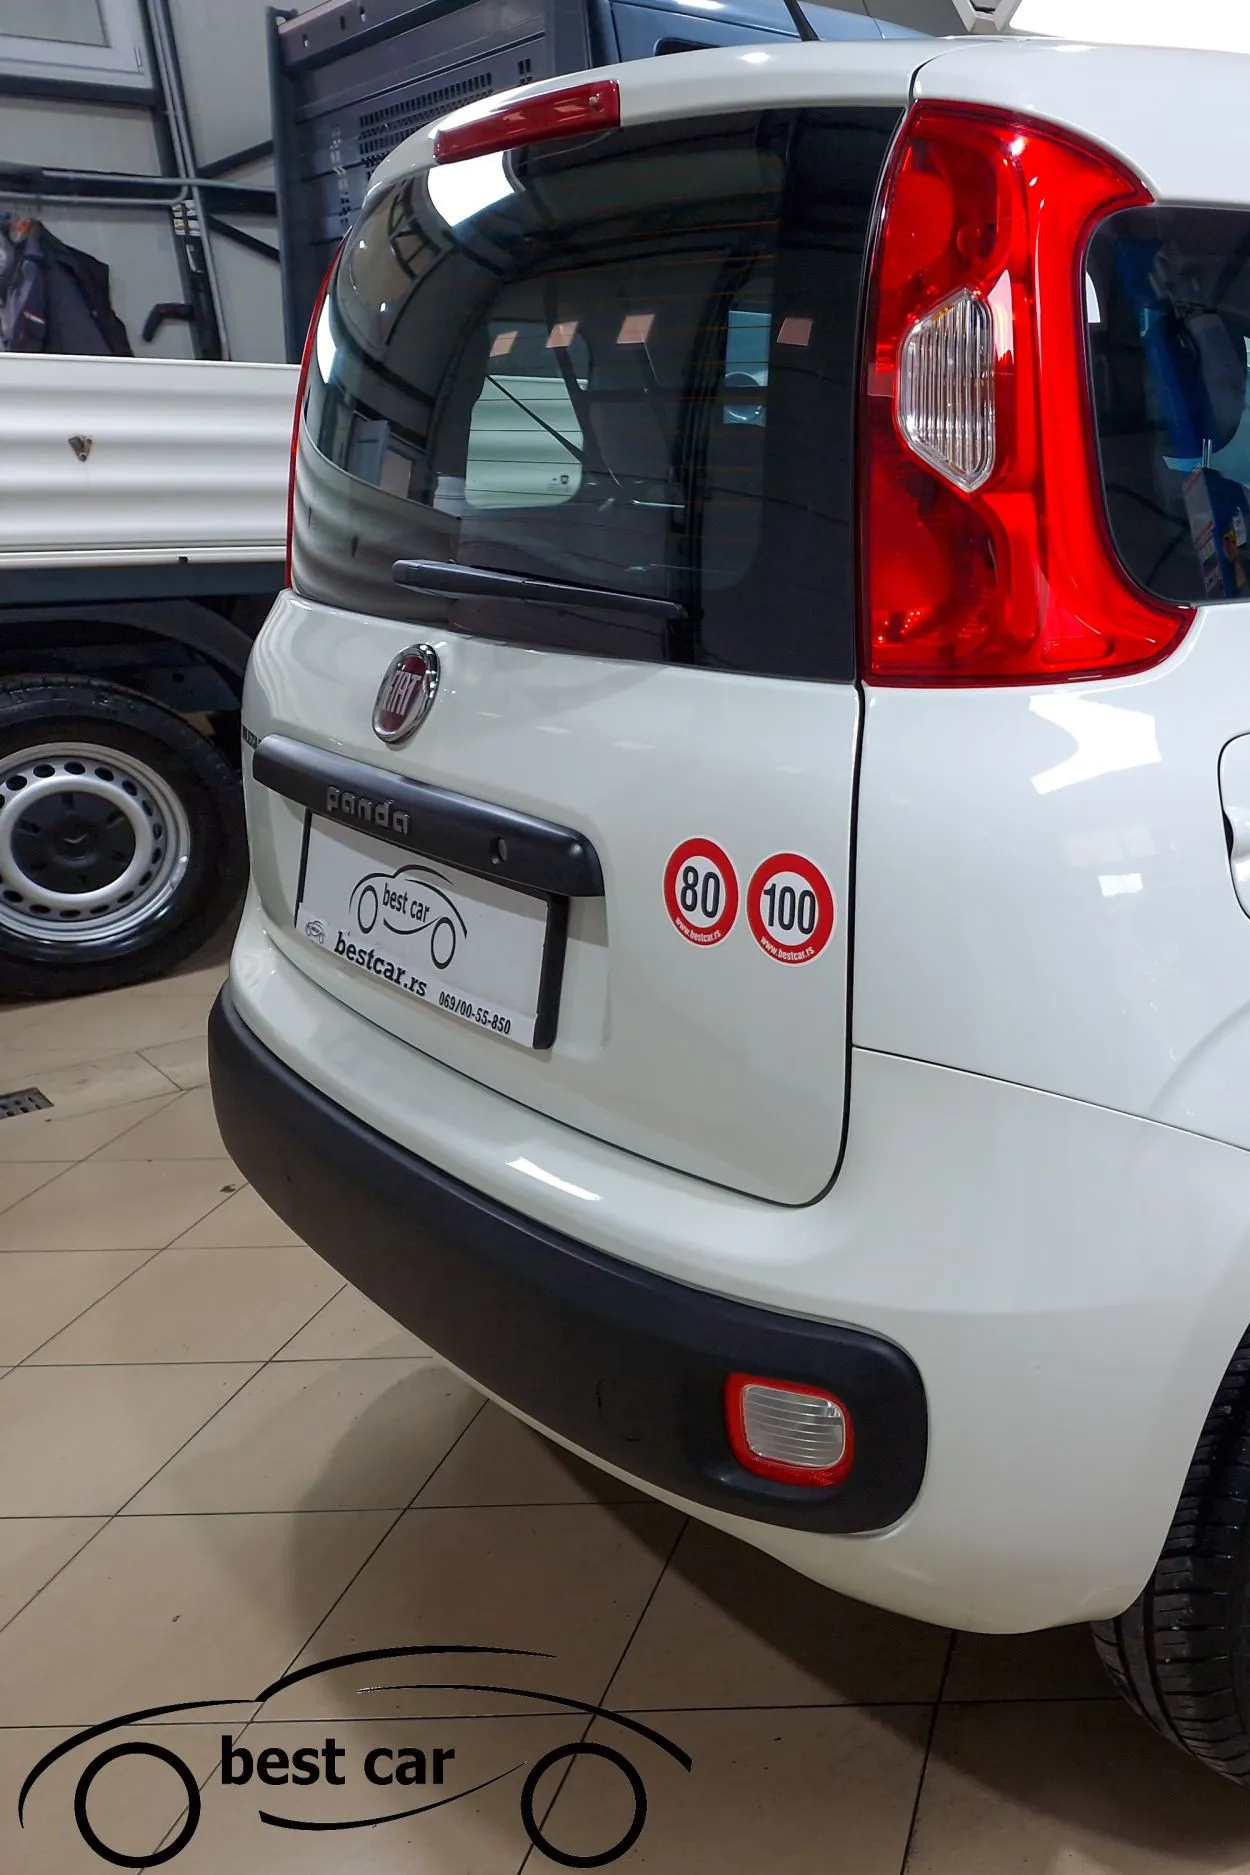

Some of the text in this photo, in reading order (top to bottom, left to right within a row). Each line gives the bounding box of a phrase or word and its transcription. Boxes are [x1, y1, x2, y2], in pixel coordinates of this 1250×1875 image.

[382, 669, 423, 716] FIAT
[326, 786, 410, 835] panda
[383, 882, 430, 923] best car
[680, 865, 721, 918] 80
[763, 883, 816, 934] 100
[674, 917, 722, 943] www.bestcar.rs
[760, 936, 815, 961] www.bestcar.rs
[334, 930, 511, 1035] bestcar.rs 069/00-55-850
